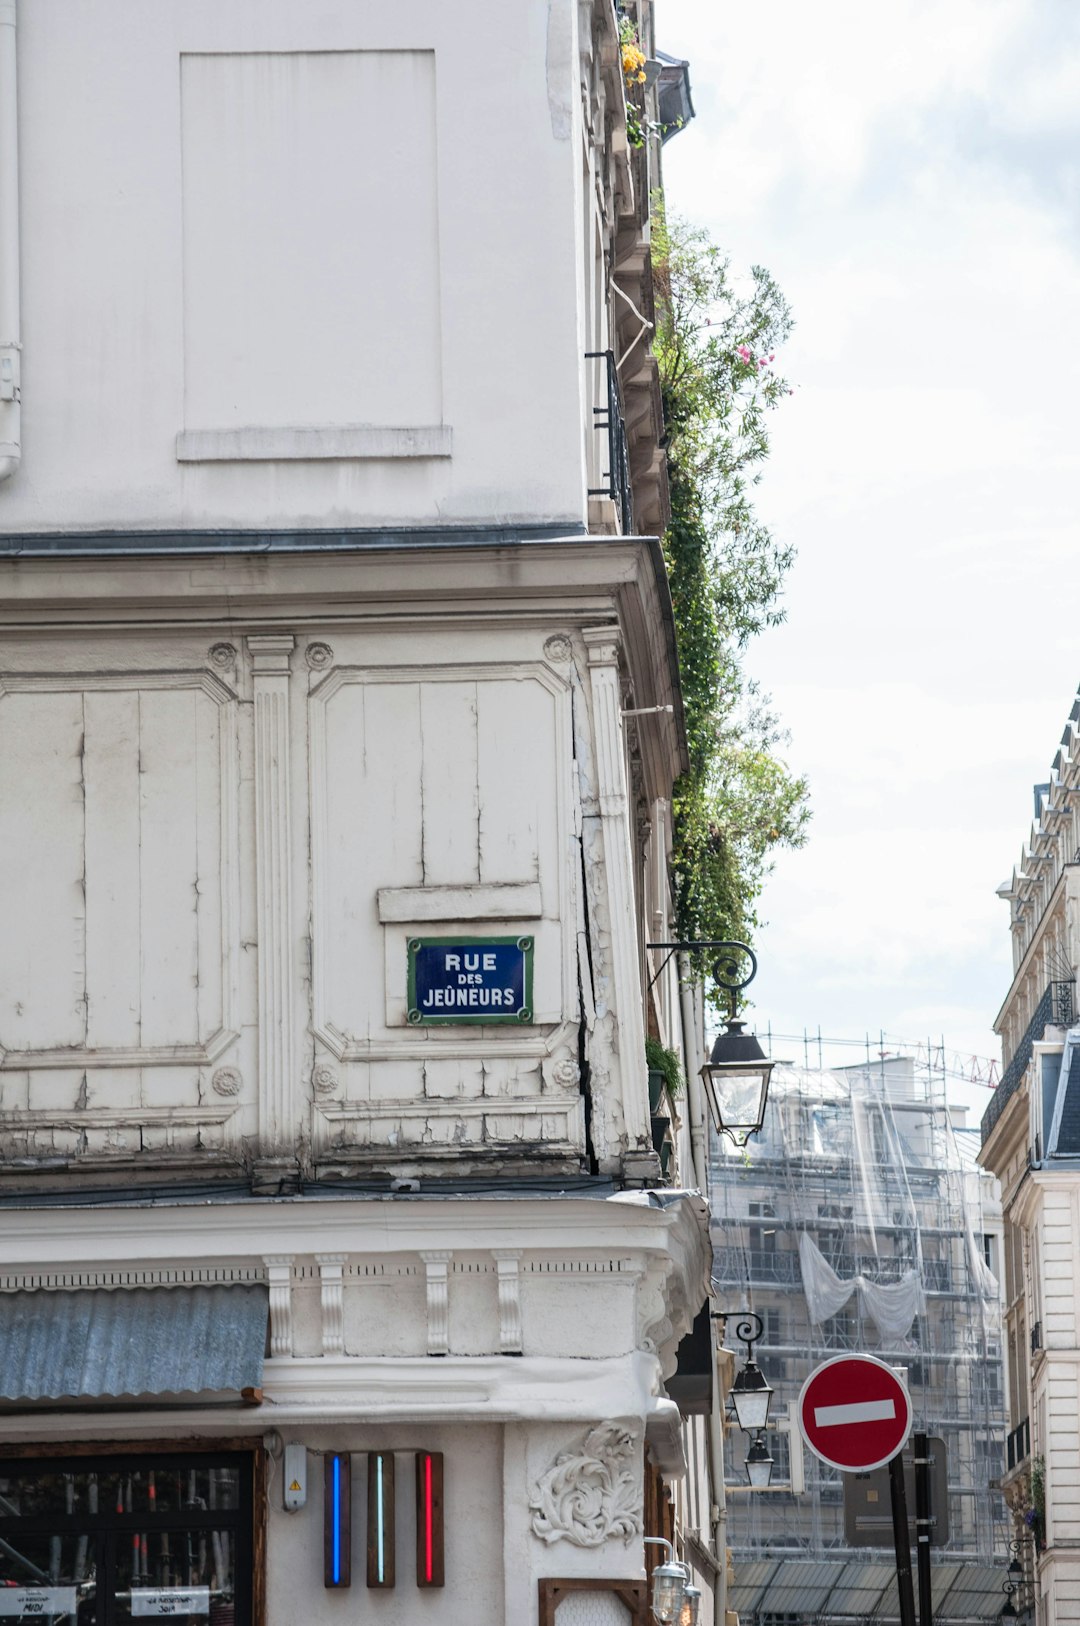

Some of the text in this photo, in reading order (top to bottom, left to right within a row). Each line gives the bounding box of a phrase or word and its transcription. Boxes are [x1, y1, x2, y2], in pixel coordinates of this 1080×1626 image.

[445, 953, 497, 971] RUE
[457, 974, 483, 985] DES
[423, 985, 515, 1007] JEÛNEURS
